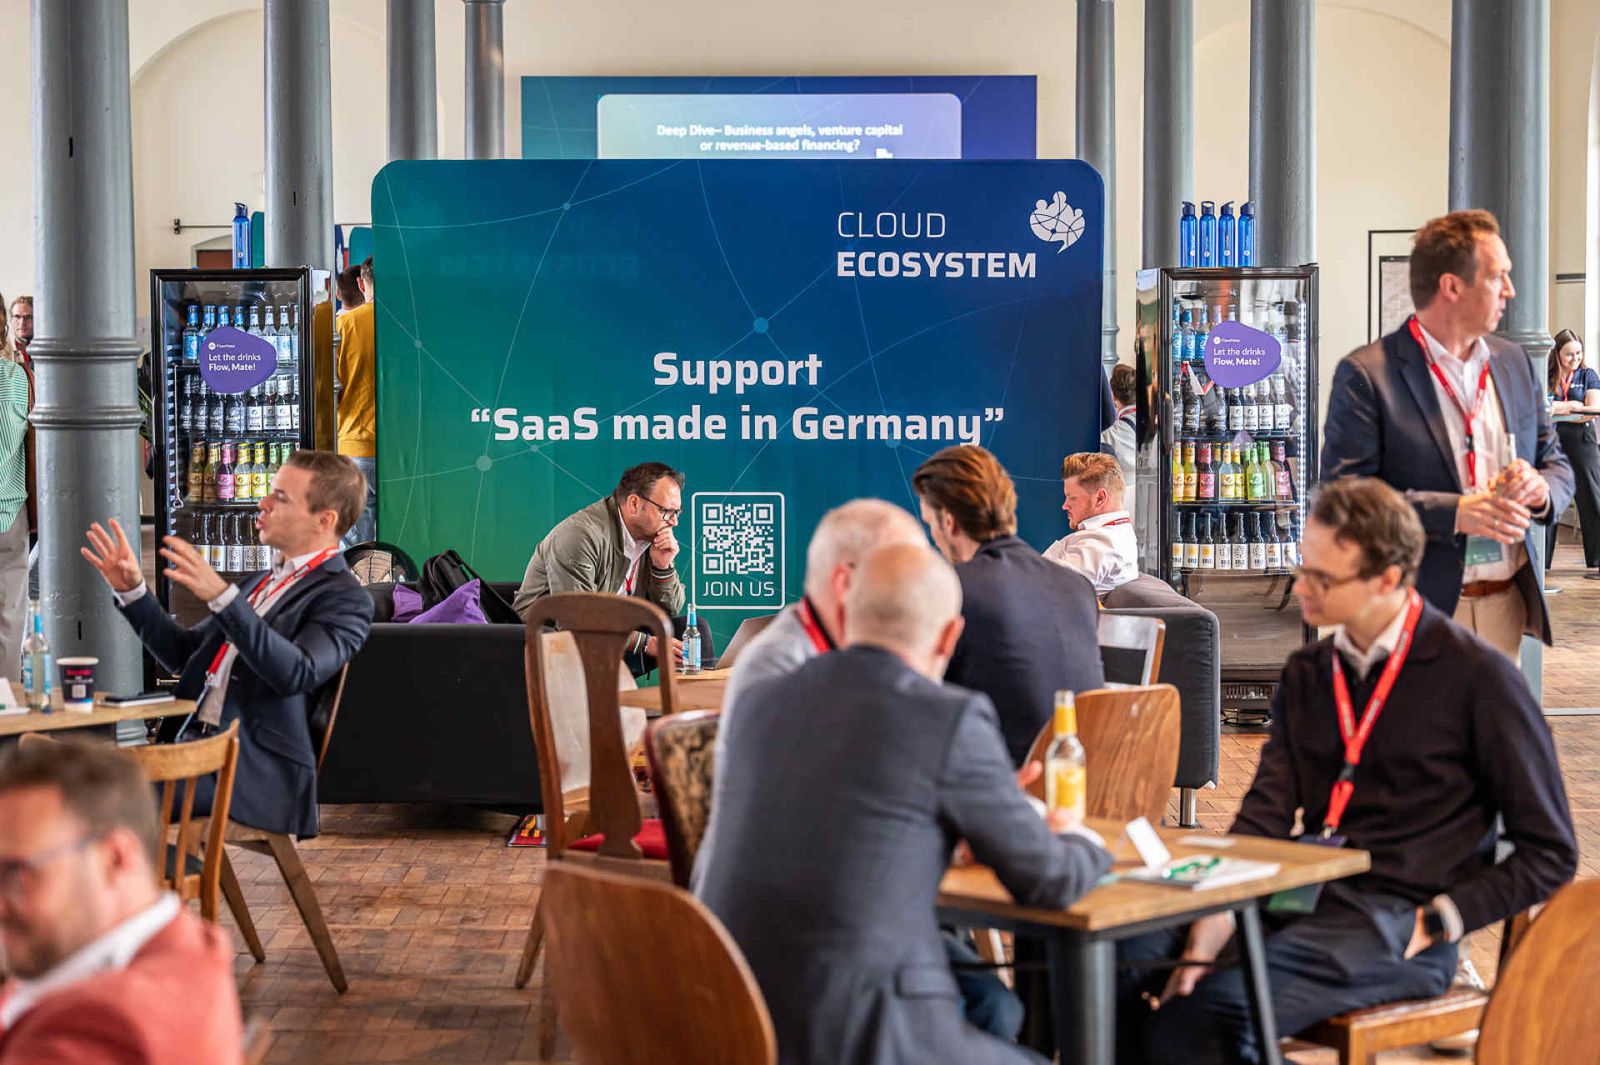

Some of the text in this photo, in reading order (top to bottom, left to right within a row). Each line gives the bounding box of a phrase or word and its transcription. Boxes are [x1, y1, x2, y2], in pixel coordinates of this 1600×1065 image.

[656, 124, 687, 138] Deep
[725, 124, 774, 136] Business
[776, 124, 816, 138] angels,
[818, 125, 862, 136] venture
[865, 124, 903, 138] capital
[700, 139, 861, 153] or revenue-based financing?
[837, 211, 946, 238] CLOUD
[837, 251, 1036, 279] ECOSYSTEM
[208, 353, 262, 361] Let the drinks
[1213, 347, 1266, 356] Let the drinks
[208, 363, 256, 372] Flow, Mate!
[1236, 357, 1260, 366] Mate!
[653, 352, 823, 394] Support
[613, 404, 727, 440] made
[741, 404, 777, 440] in
[703, 581, 775, 597] JOIN US
